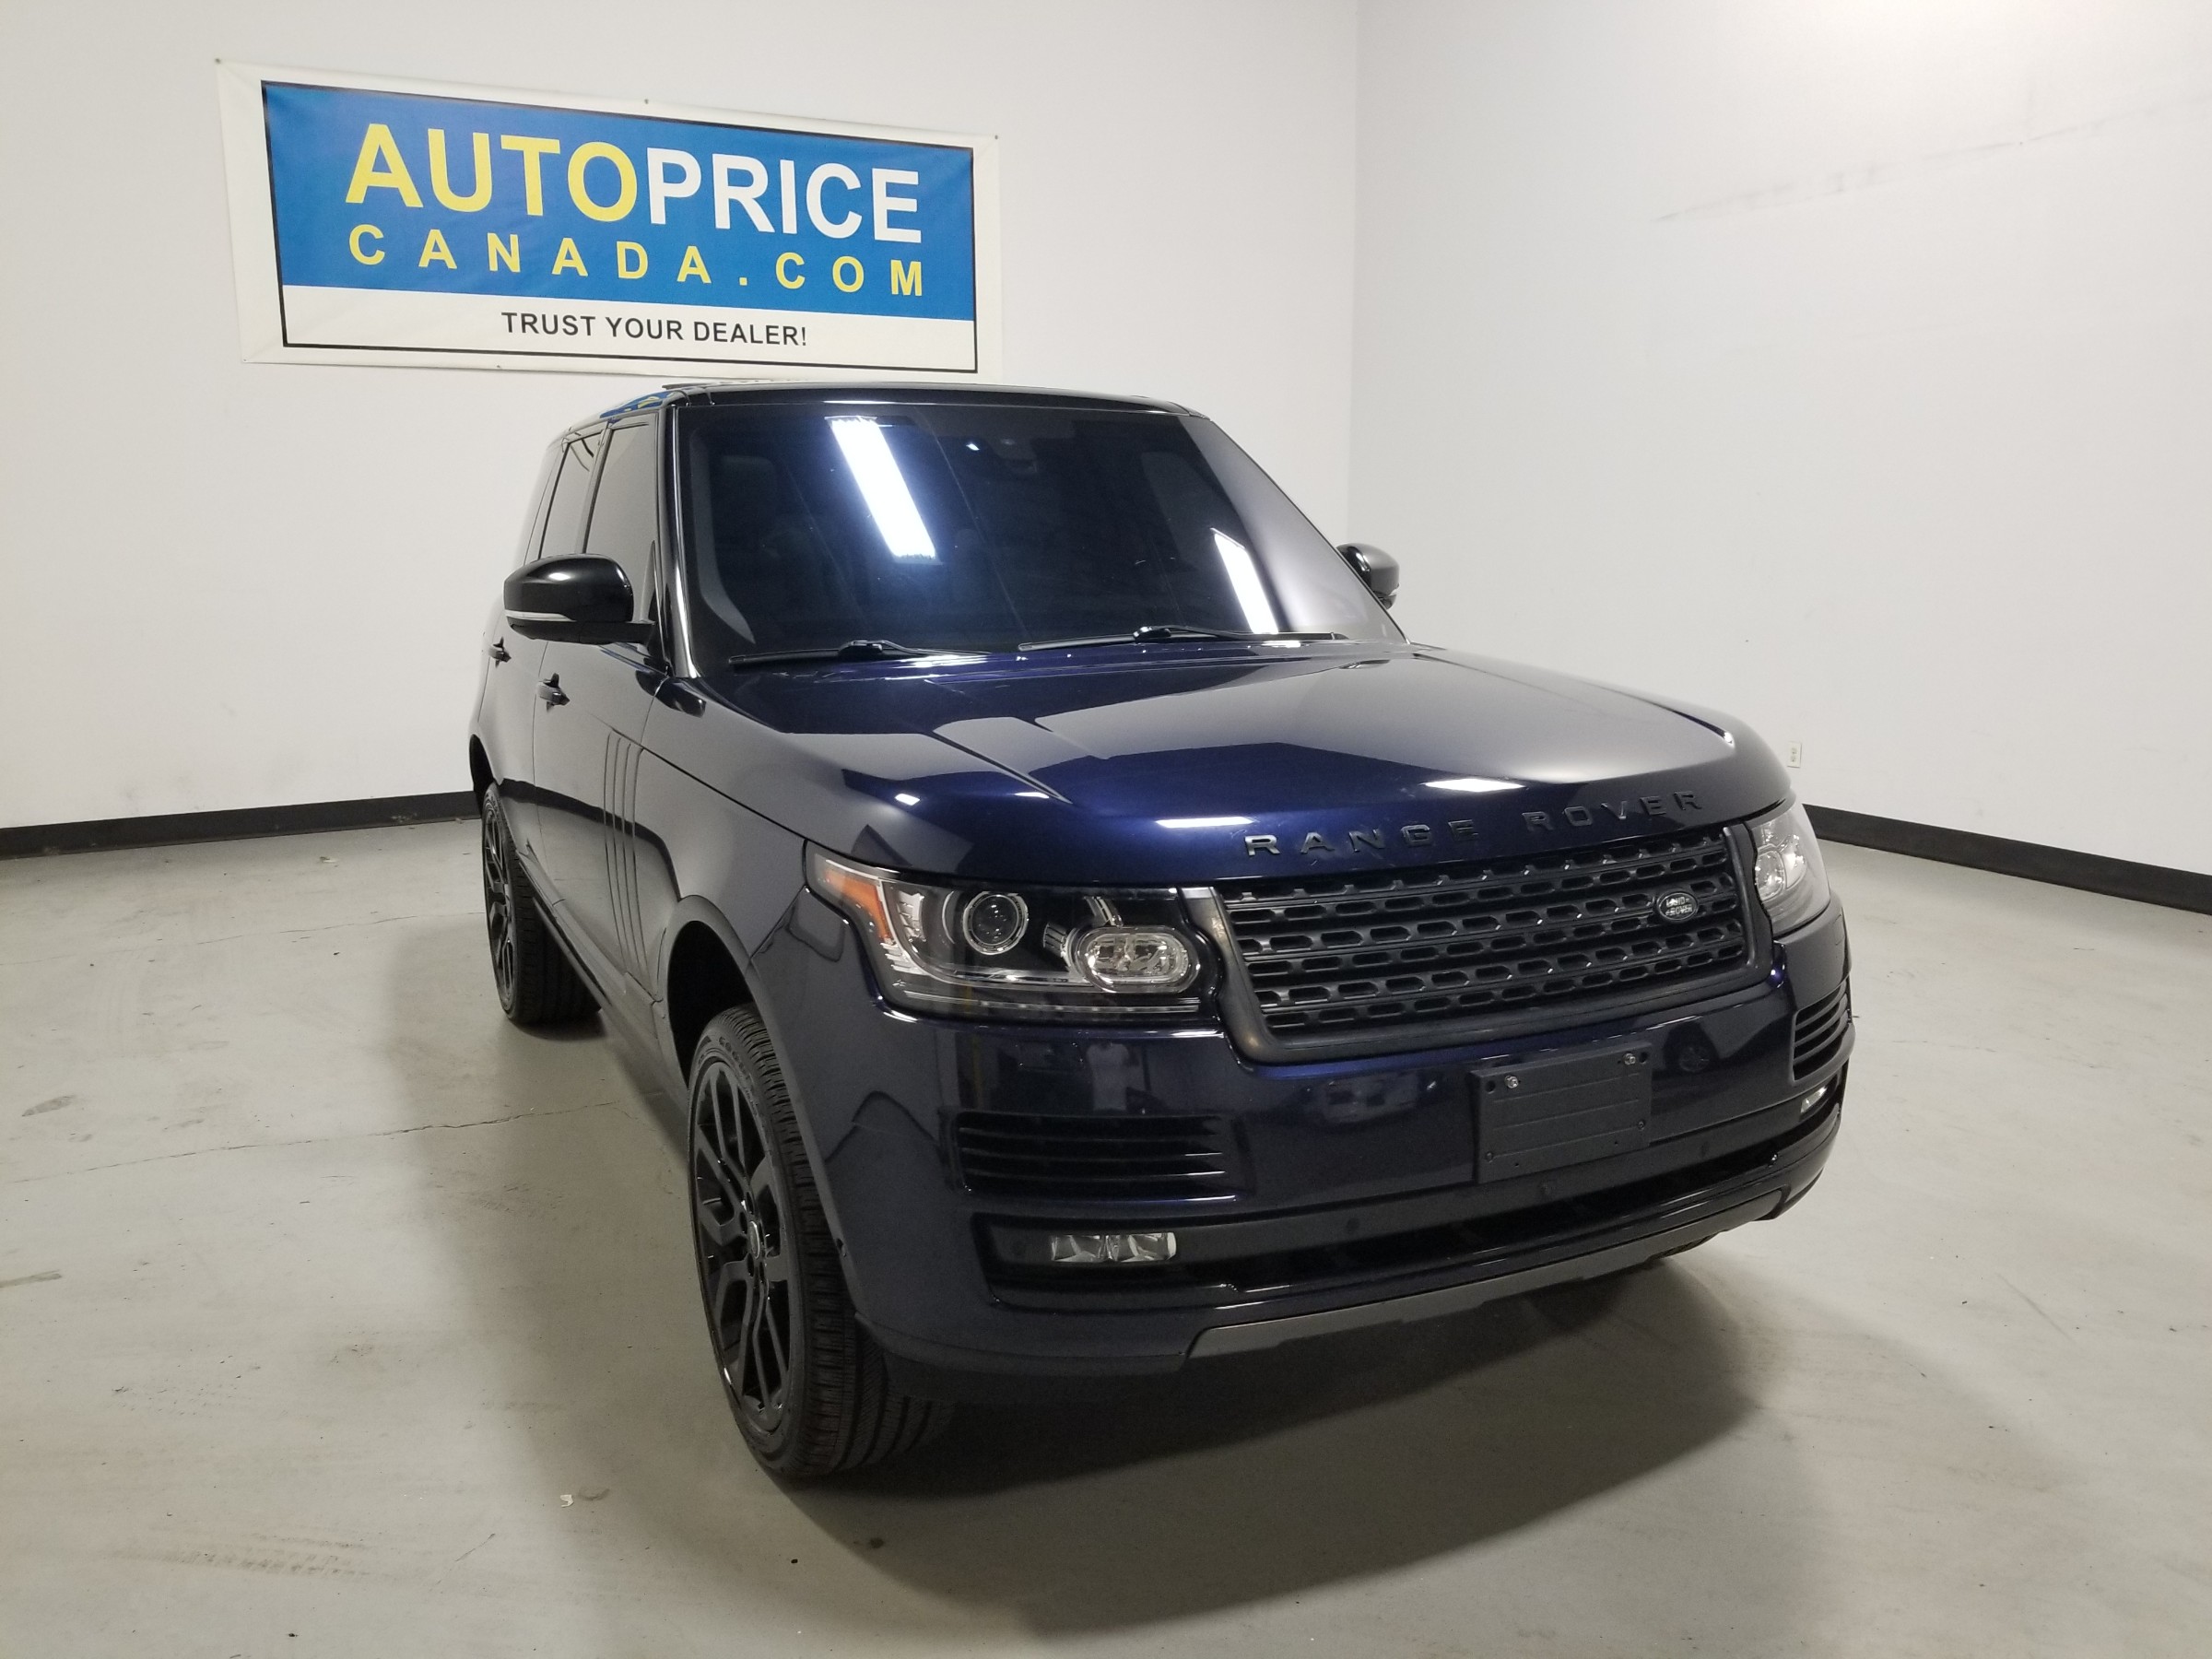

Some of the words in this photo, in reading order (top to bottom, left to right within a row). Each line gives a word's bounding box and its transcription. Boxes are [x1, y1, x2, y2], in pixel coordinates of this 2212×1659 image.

[345, 122, 923, 244] AUTOPRICE
[347, 223, 924, 297] CANADA.COM
[501, 312, 597, 336] TRUST
[605, 317, 685, 343] YOUR
[693, 322, 808, 347] DEALER!
[1244, 818, 1478, 857] RANGE
[1522, 790, 1702, 830] ROVER
